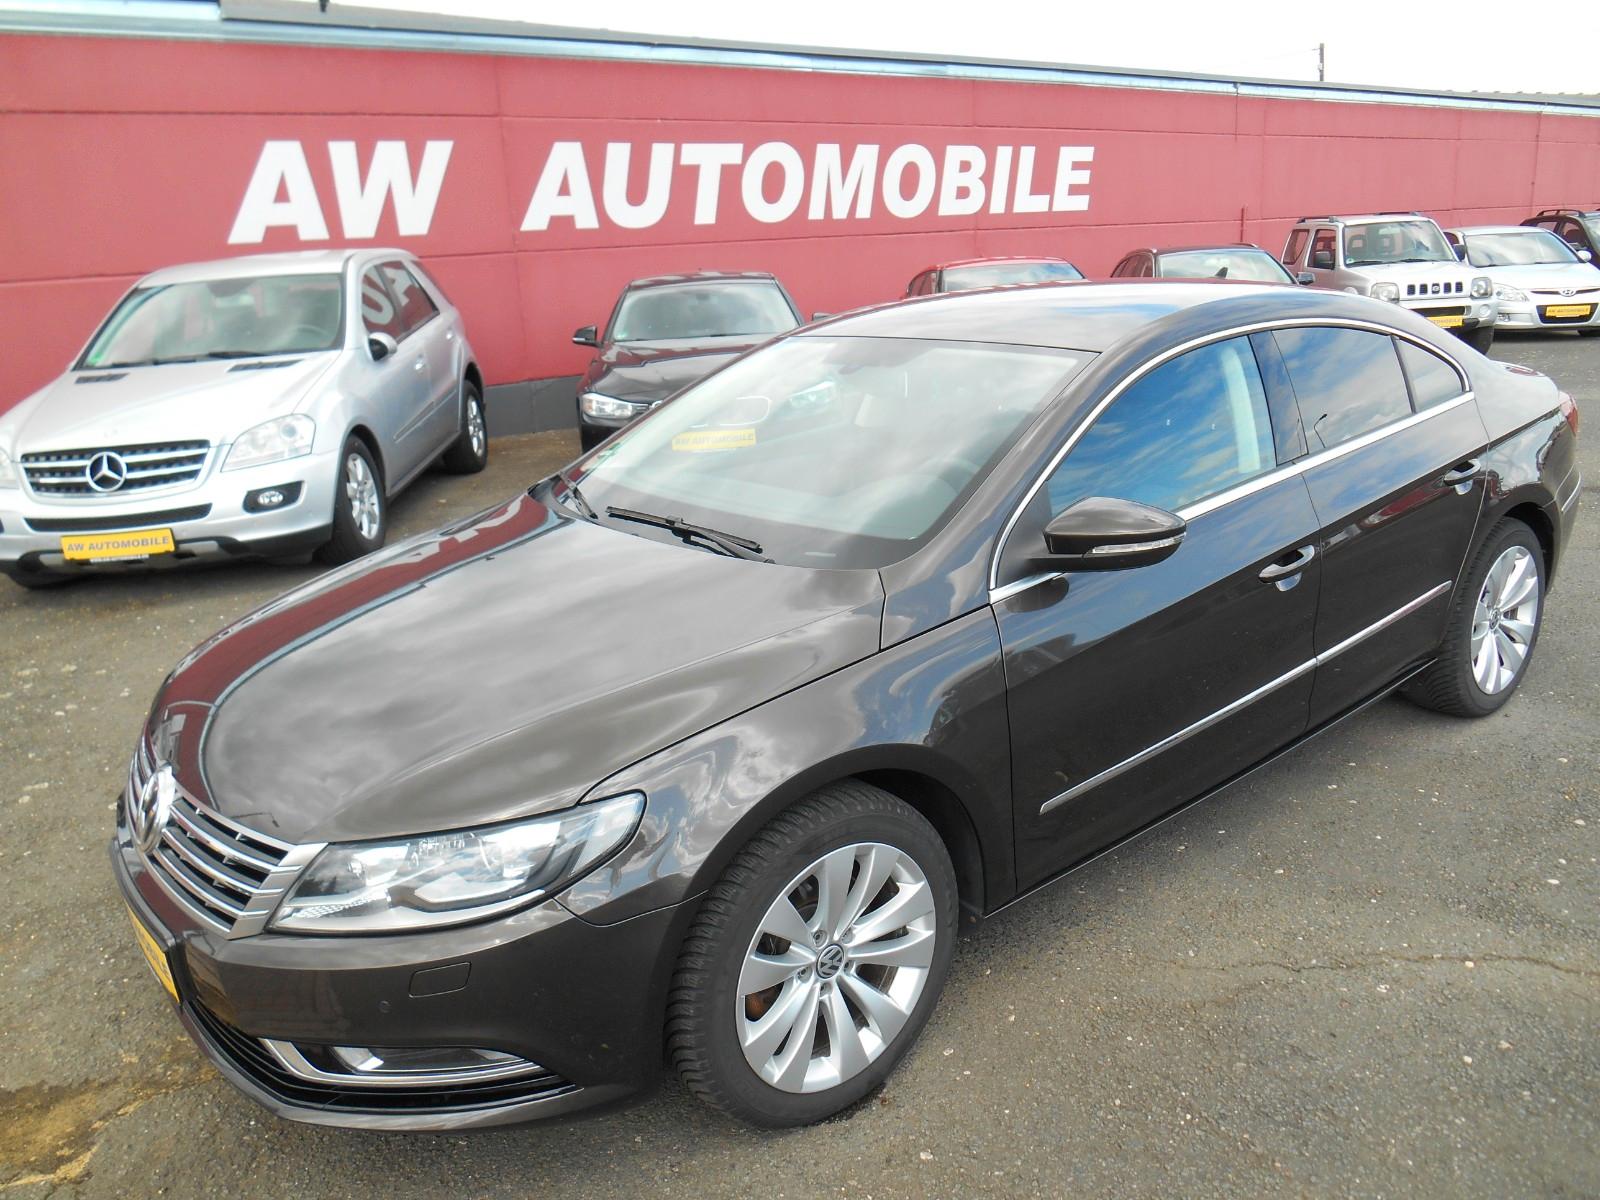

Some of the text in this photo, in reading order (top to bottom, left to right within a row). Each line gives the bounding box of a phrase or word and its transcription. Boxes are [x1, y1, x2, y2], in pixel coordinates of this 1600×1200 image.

[227, 139, 1095, 245] AW AUTOMOBILE
[67, 536, 169, 552] AW AUTOMOBILE
